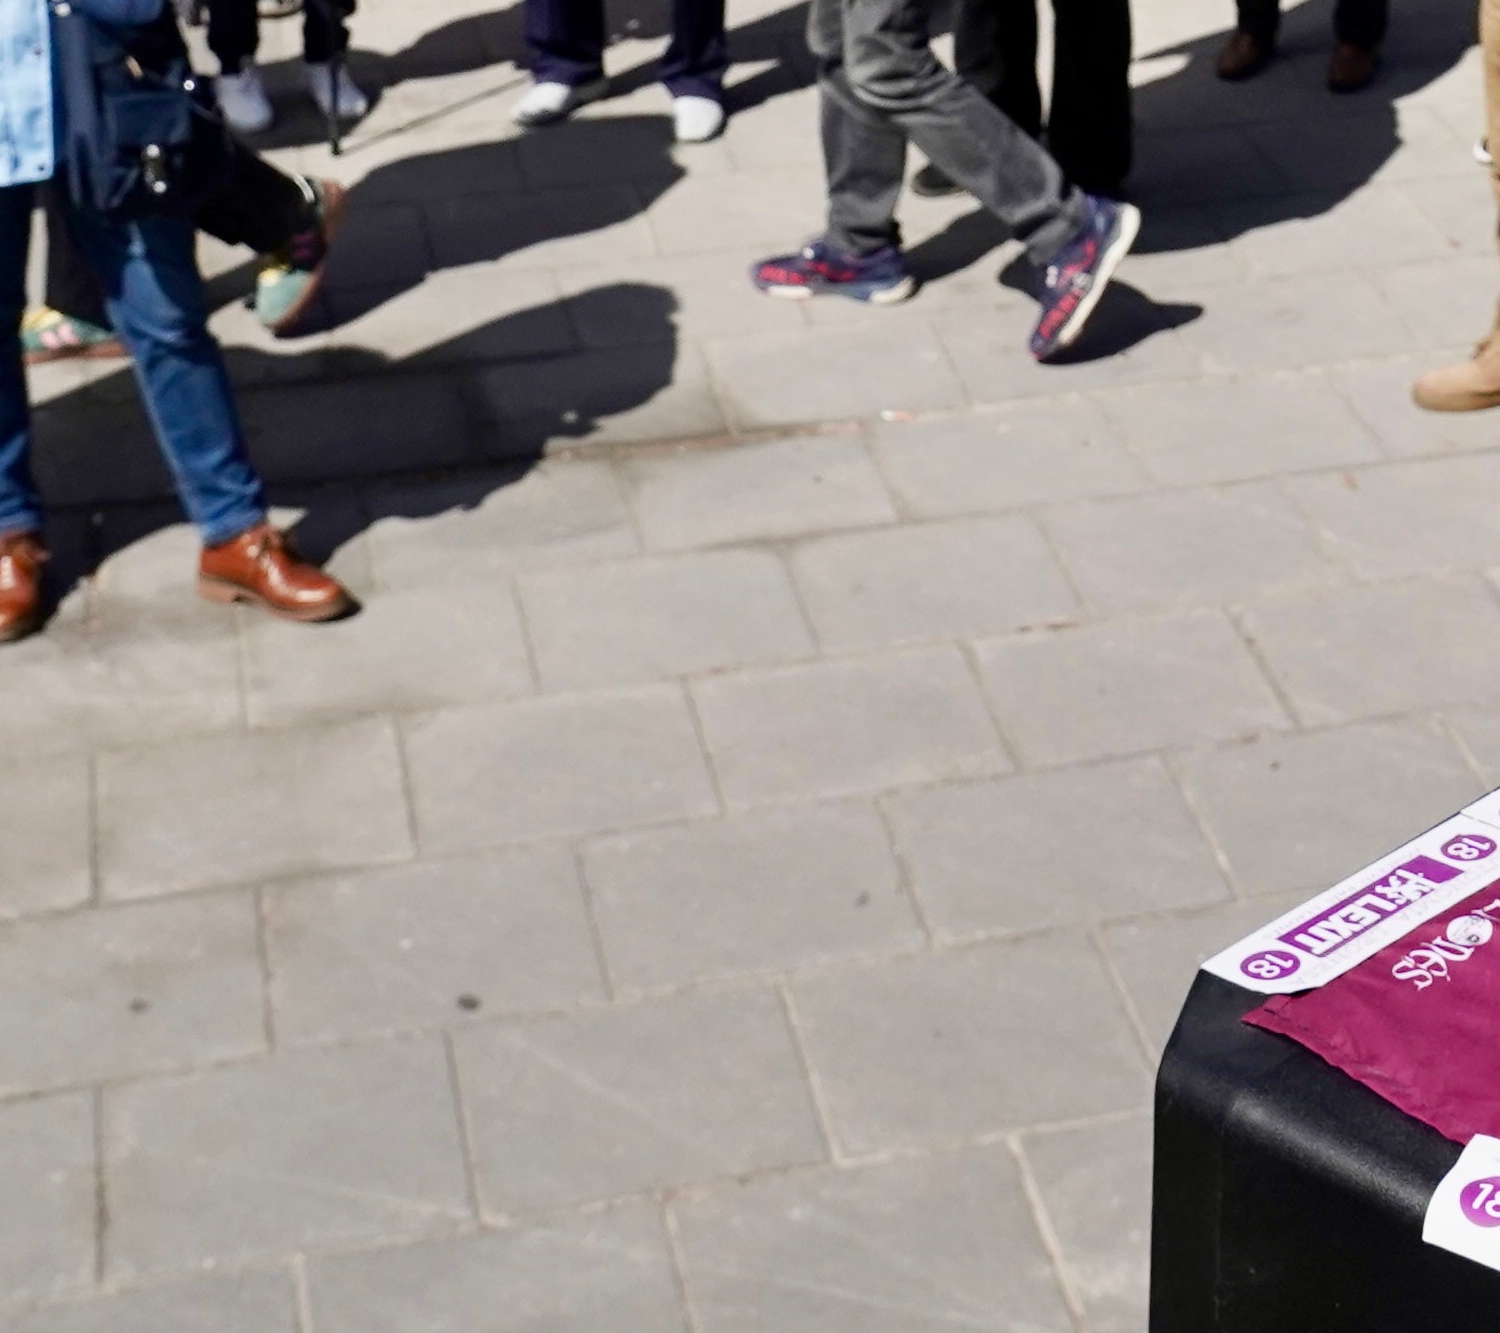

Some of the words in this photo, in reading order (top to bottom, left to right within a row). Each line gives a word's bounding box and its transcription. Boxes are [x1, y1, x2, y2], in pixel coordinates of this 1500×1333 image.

[1446, 836, 1491, 860] 18
[1294, 893, 1398, 956] LEXIT
[1247, 953, 1295, 979] 18
